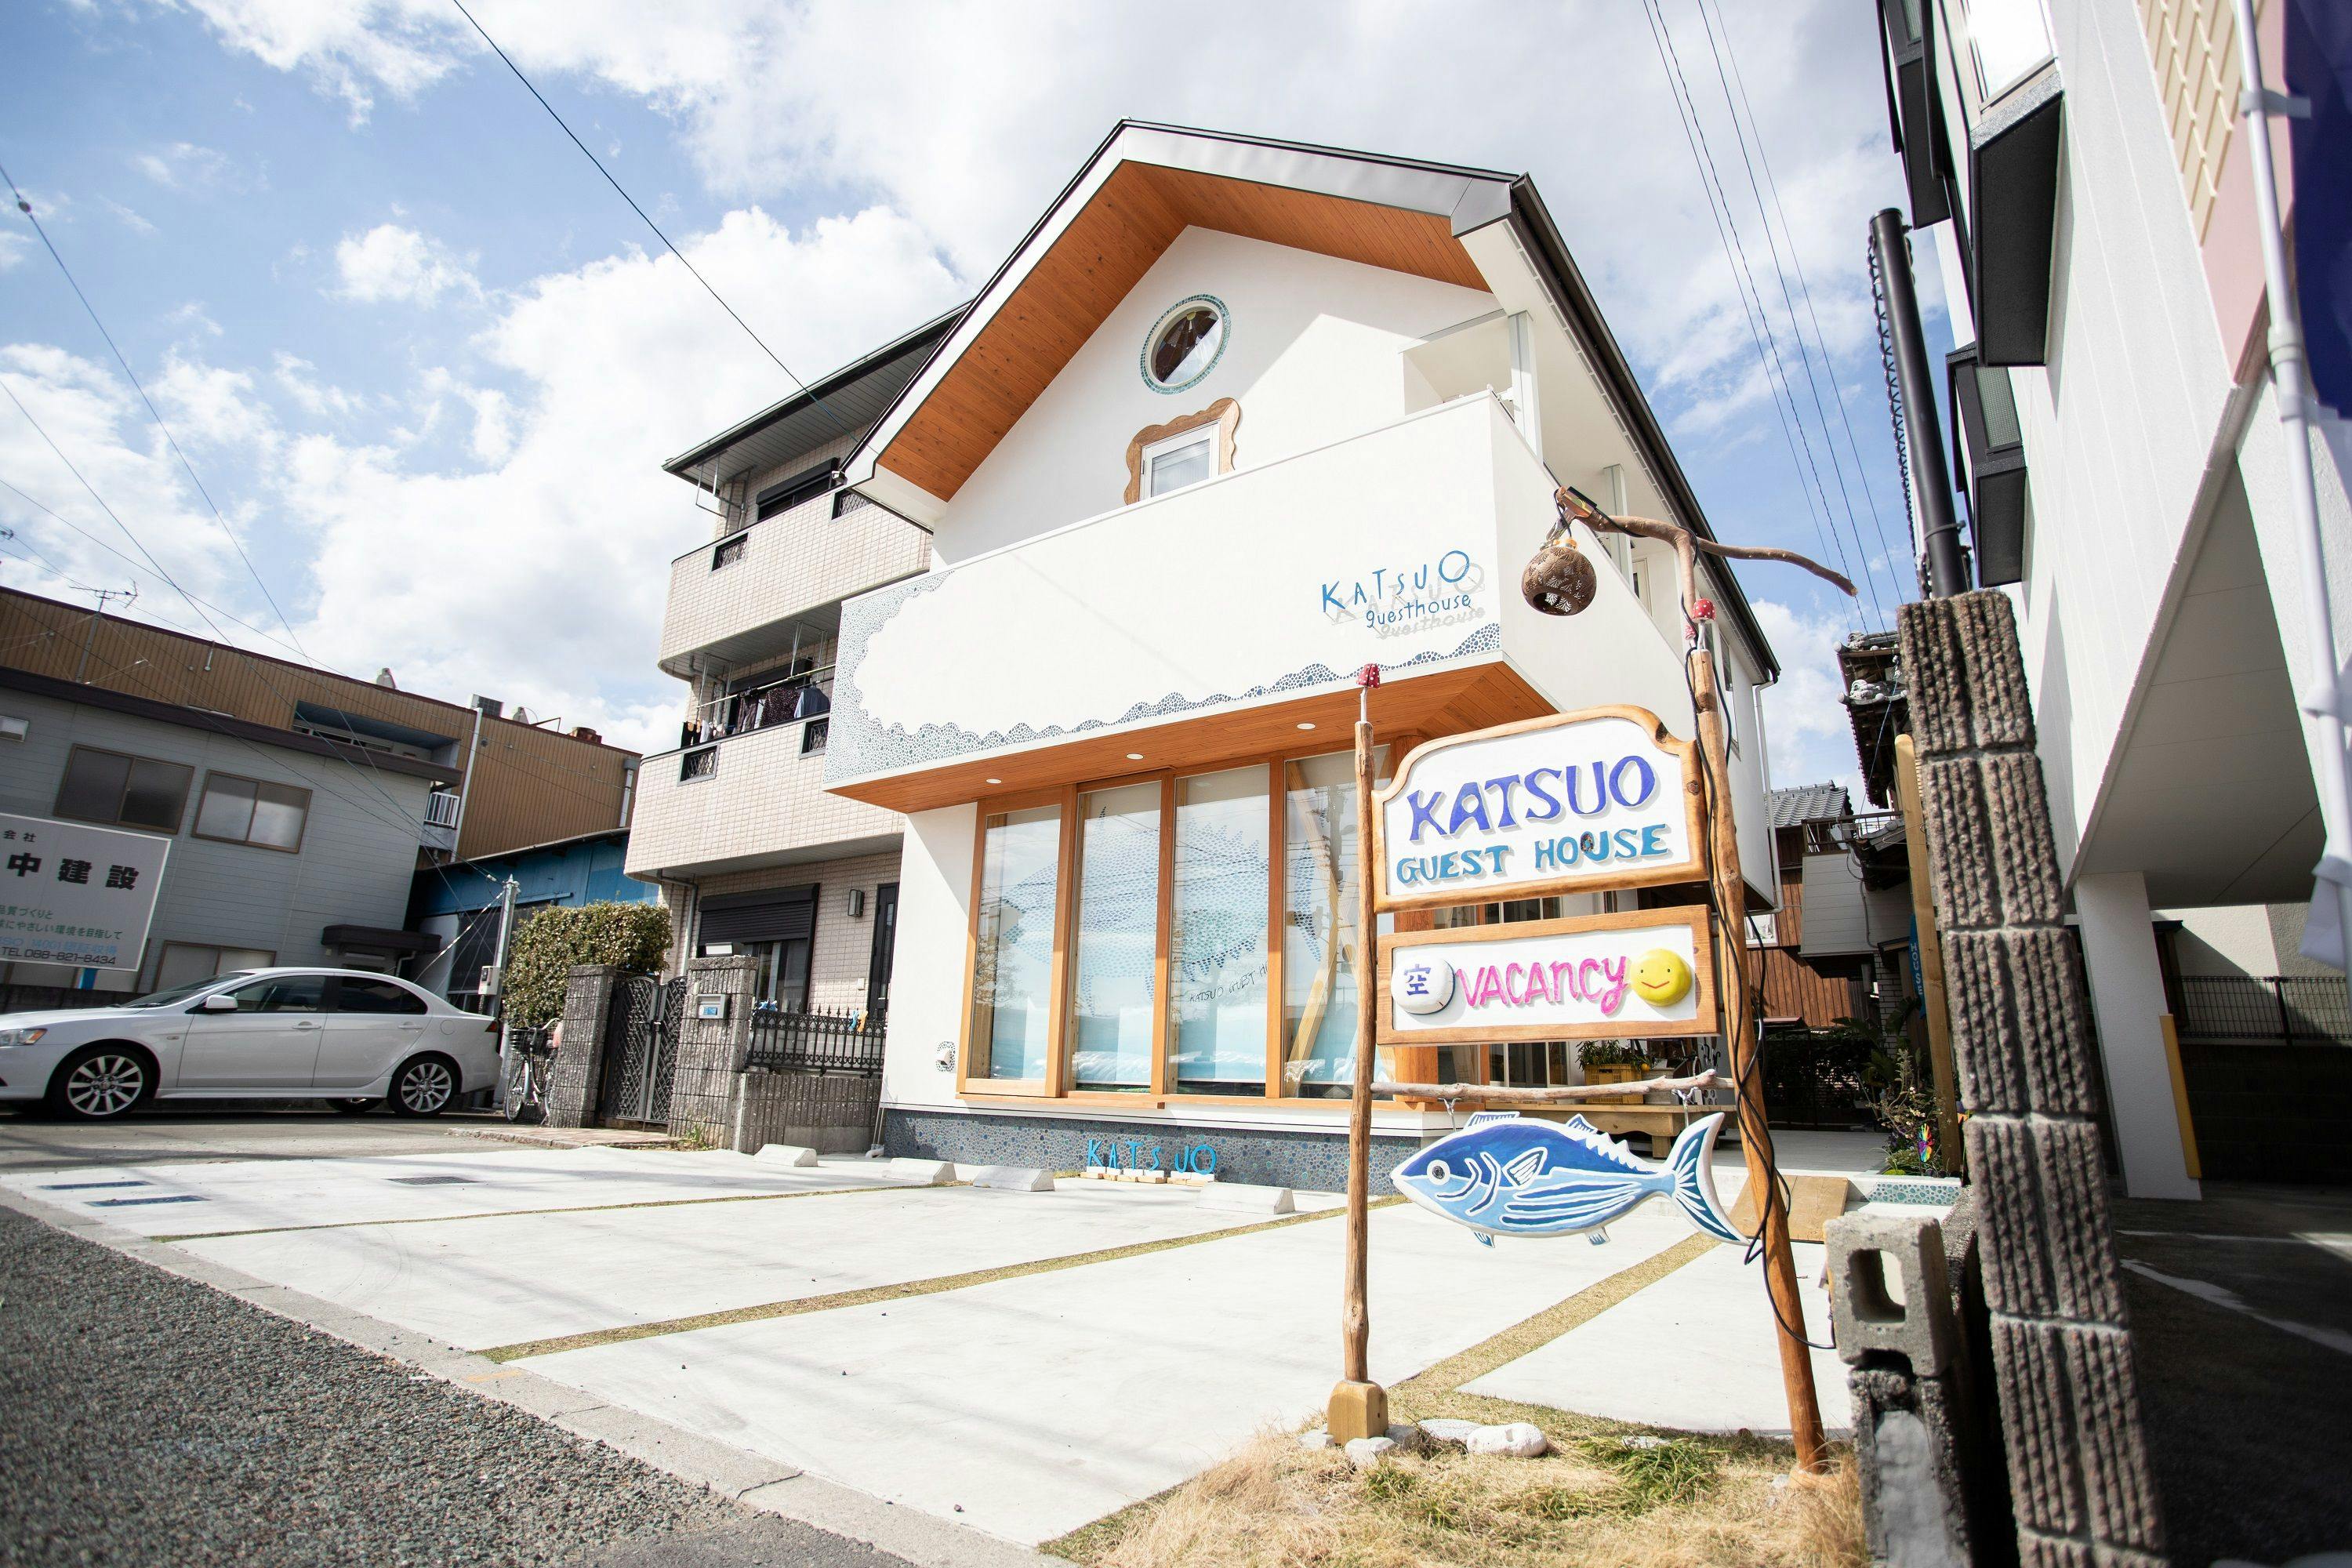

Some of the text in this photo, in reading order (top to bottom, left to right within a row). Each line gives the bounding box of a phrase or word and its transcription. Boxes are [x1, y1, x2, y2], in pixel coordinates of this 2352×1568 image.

[1322, 550, 1471, 612] KATSUO
[1366, 594, 1471, 628] guesthouse
[1407, 755, 1657, 841] KATSUO
[3, 829, 36, 843] 会社
[1396, 824, 1668, 884] GUEST HOUSE
[6, 852, 140, 891] 中建設
[1403, 964, 1432, 996] 空
